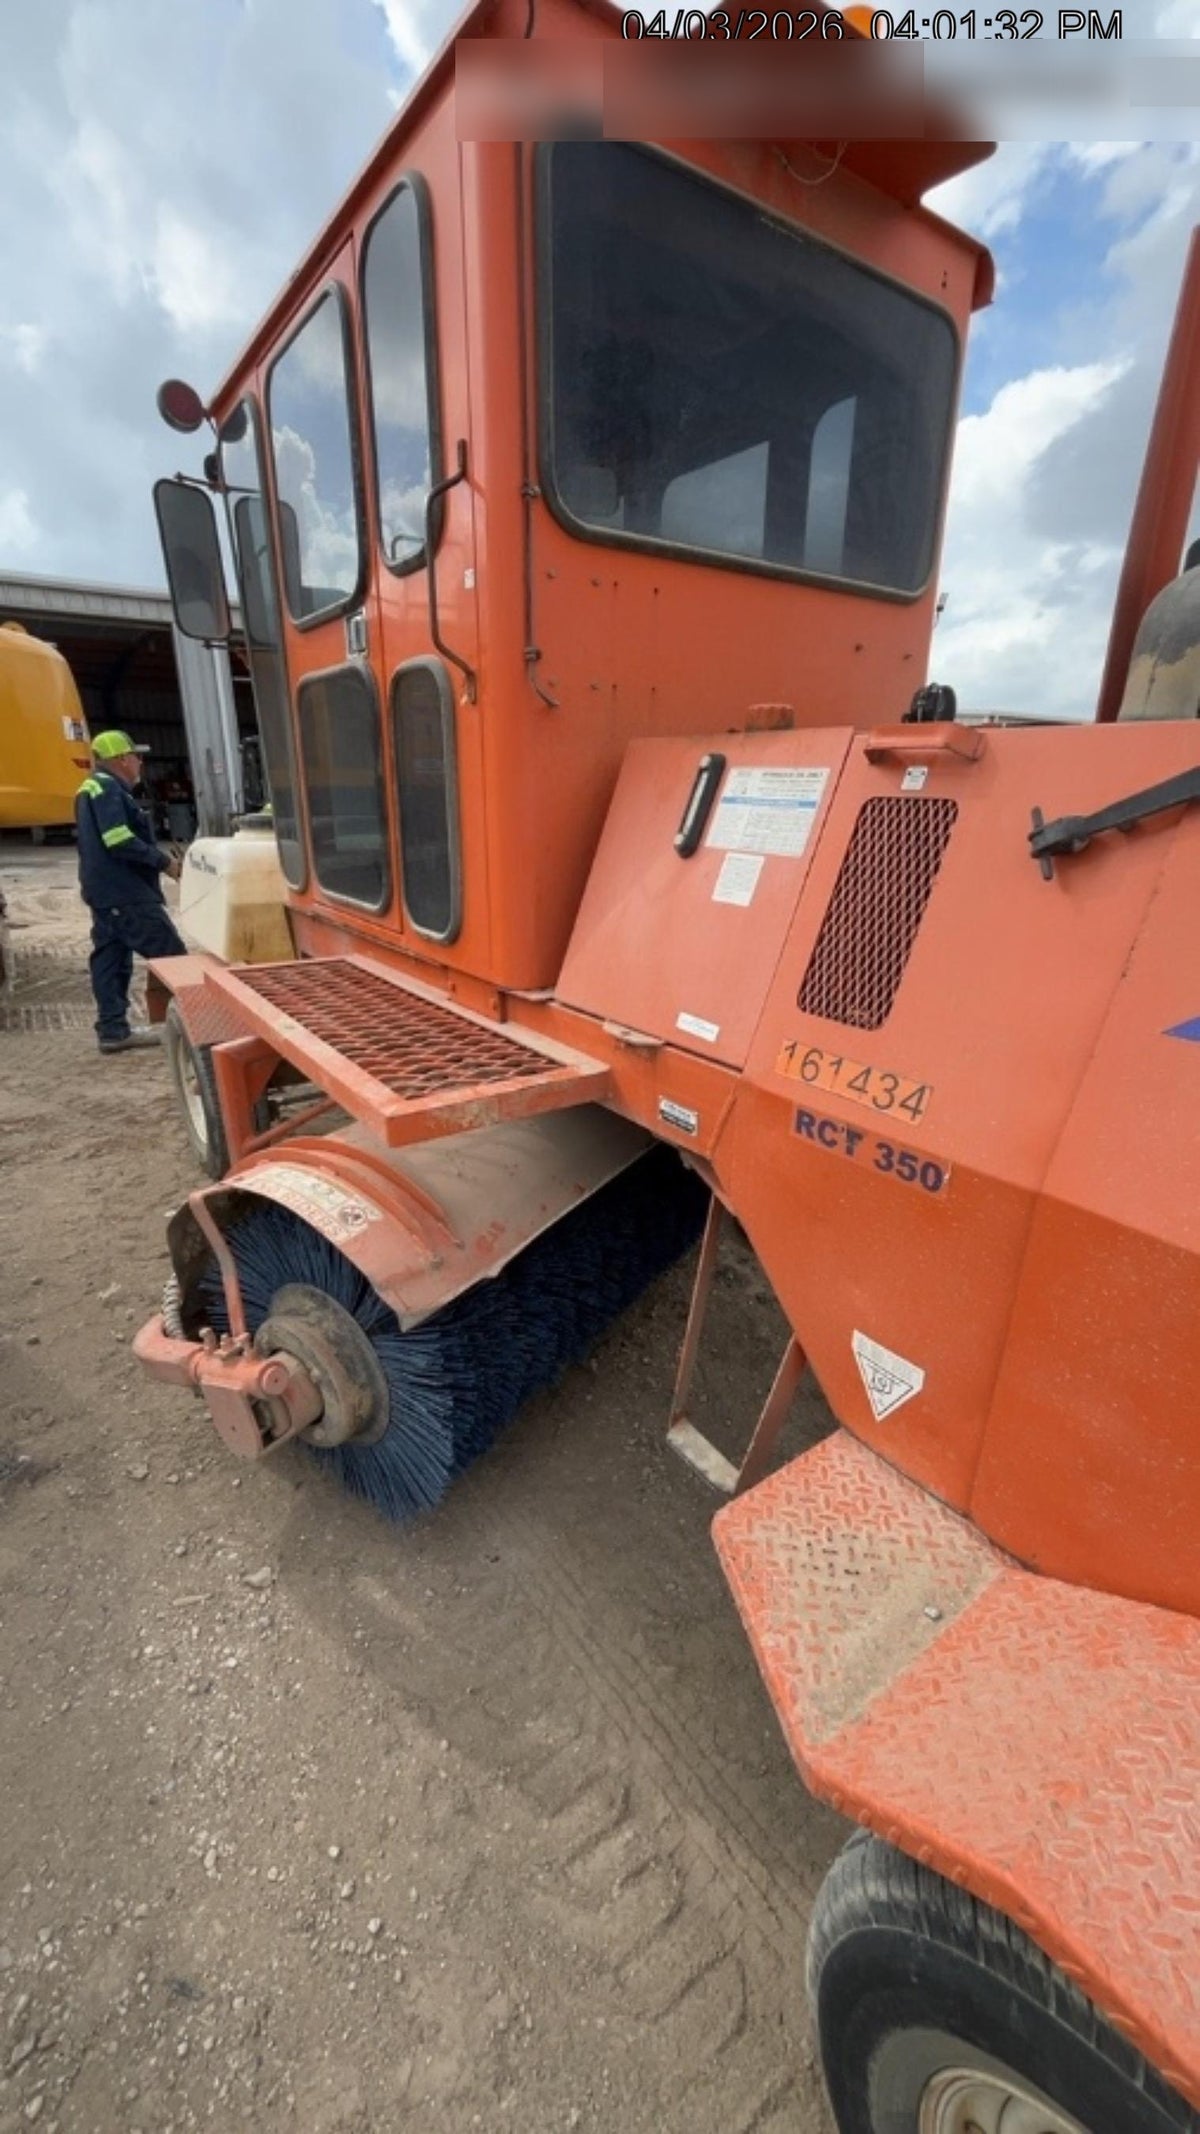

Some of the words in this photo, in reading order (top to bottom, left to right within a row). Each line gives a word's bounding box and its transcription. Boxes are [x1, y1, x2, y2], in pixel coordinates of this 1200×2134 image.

[783, 1040, 928, 1121] 161434
[794, 1108, 864, 1157] RCT
[873, 1141, 944, 1193] 350
